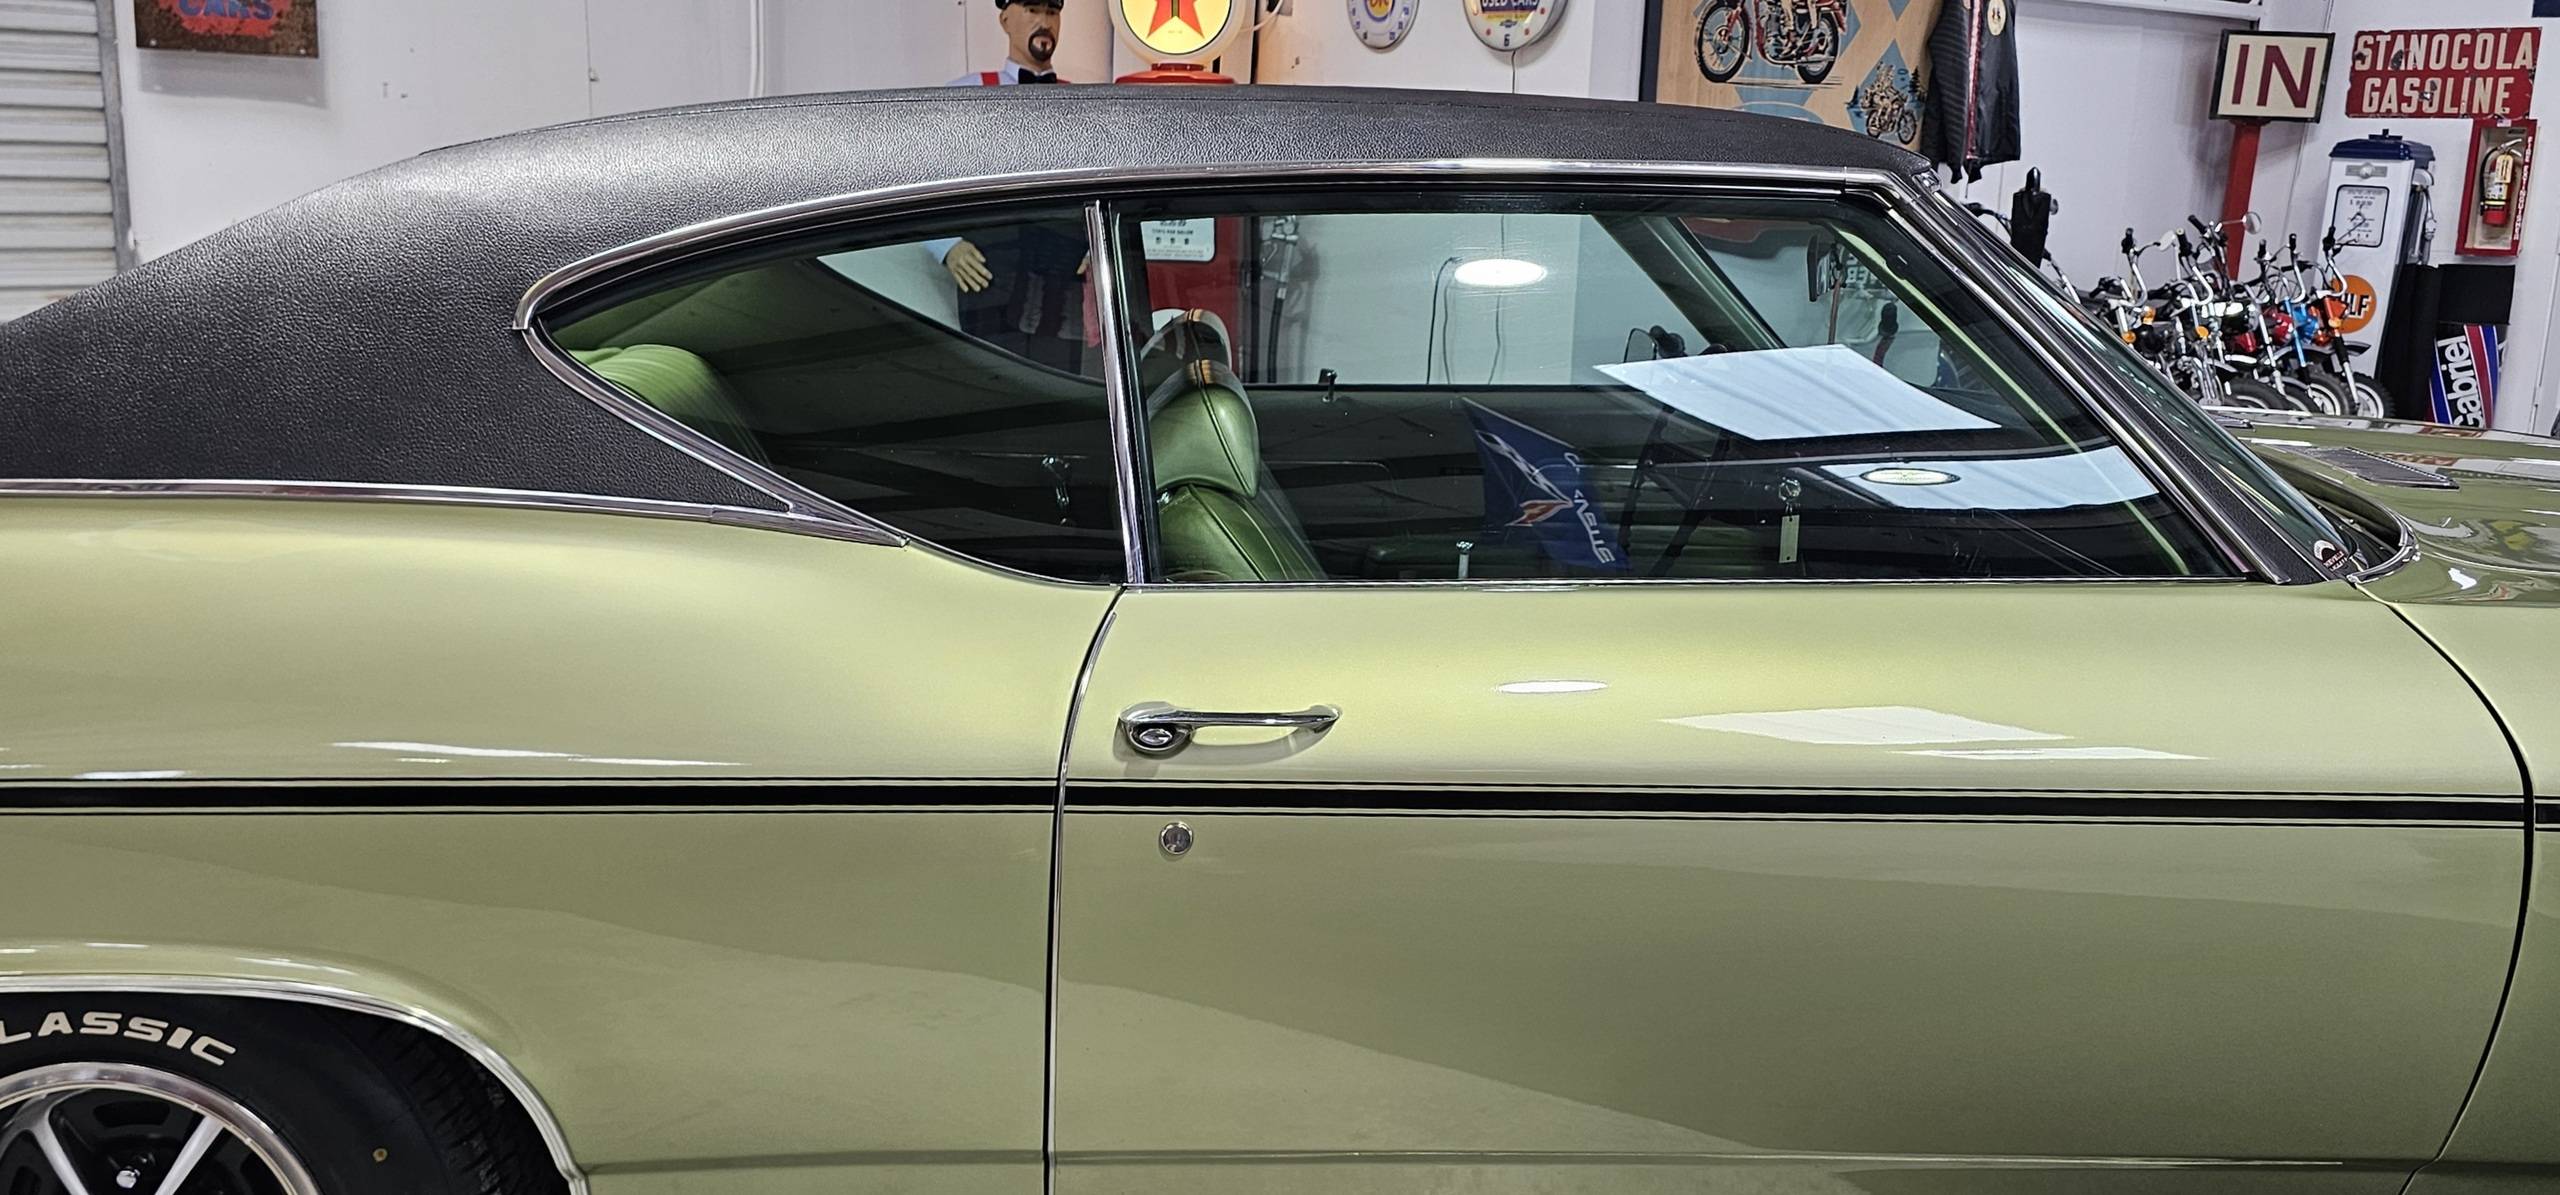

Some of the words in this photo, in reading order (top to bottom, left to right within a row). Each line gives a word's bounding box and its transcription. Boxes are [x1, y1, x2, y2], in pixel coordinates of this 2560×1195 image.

[2231, 44, 2316, 109] IN
[2354, 31, 2533, 71] STANOCOLA
[2362, 76, 2514, 115] GASOLINE
[2437, 335, 2486, 429] Gabriel
